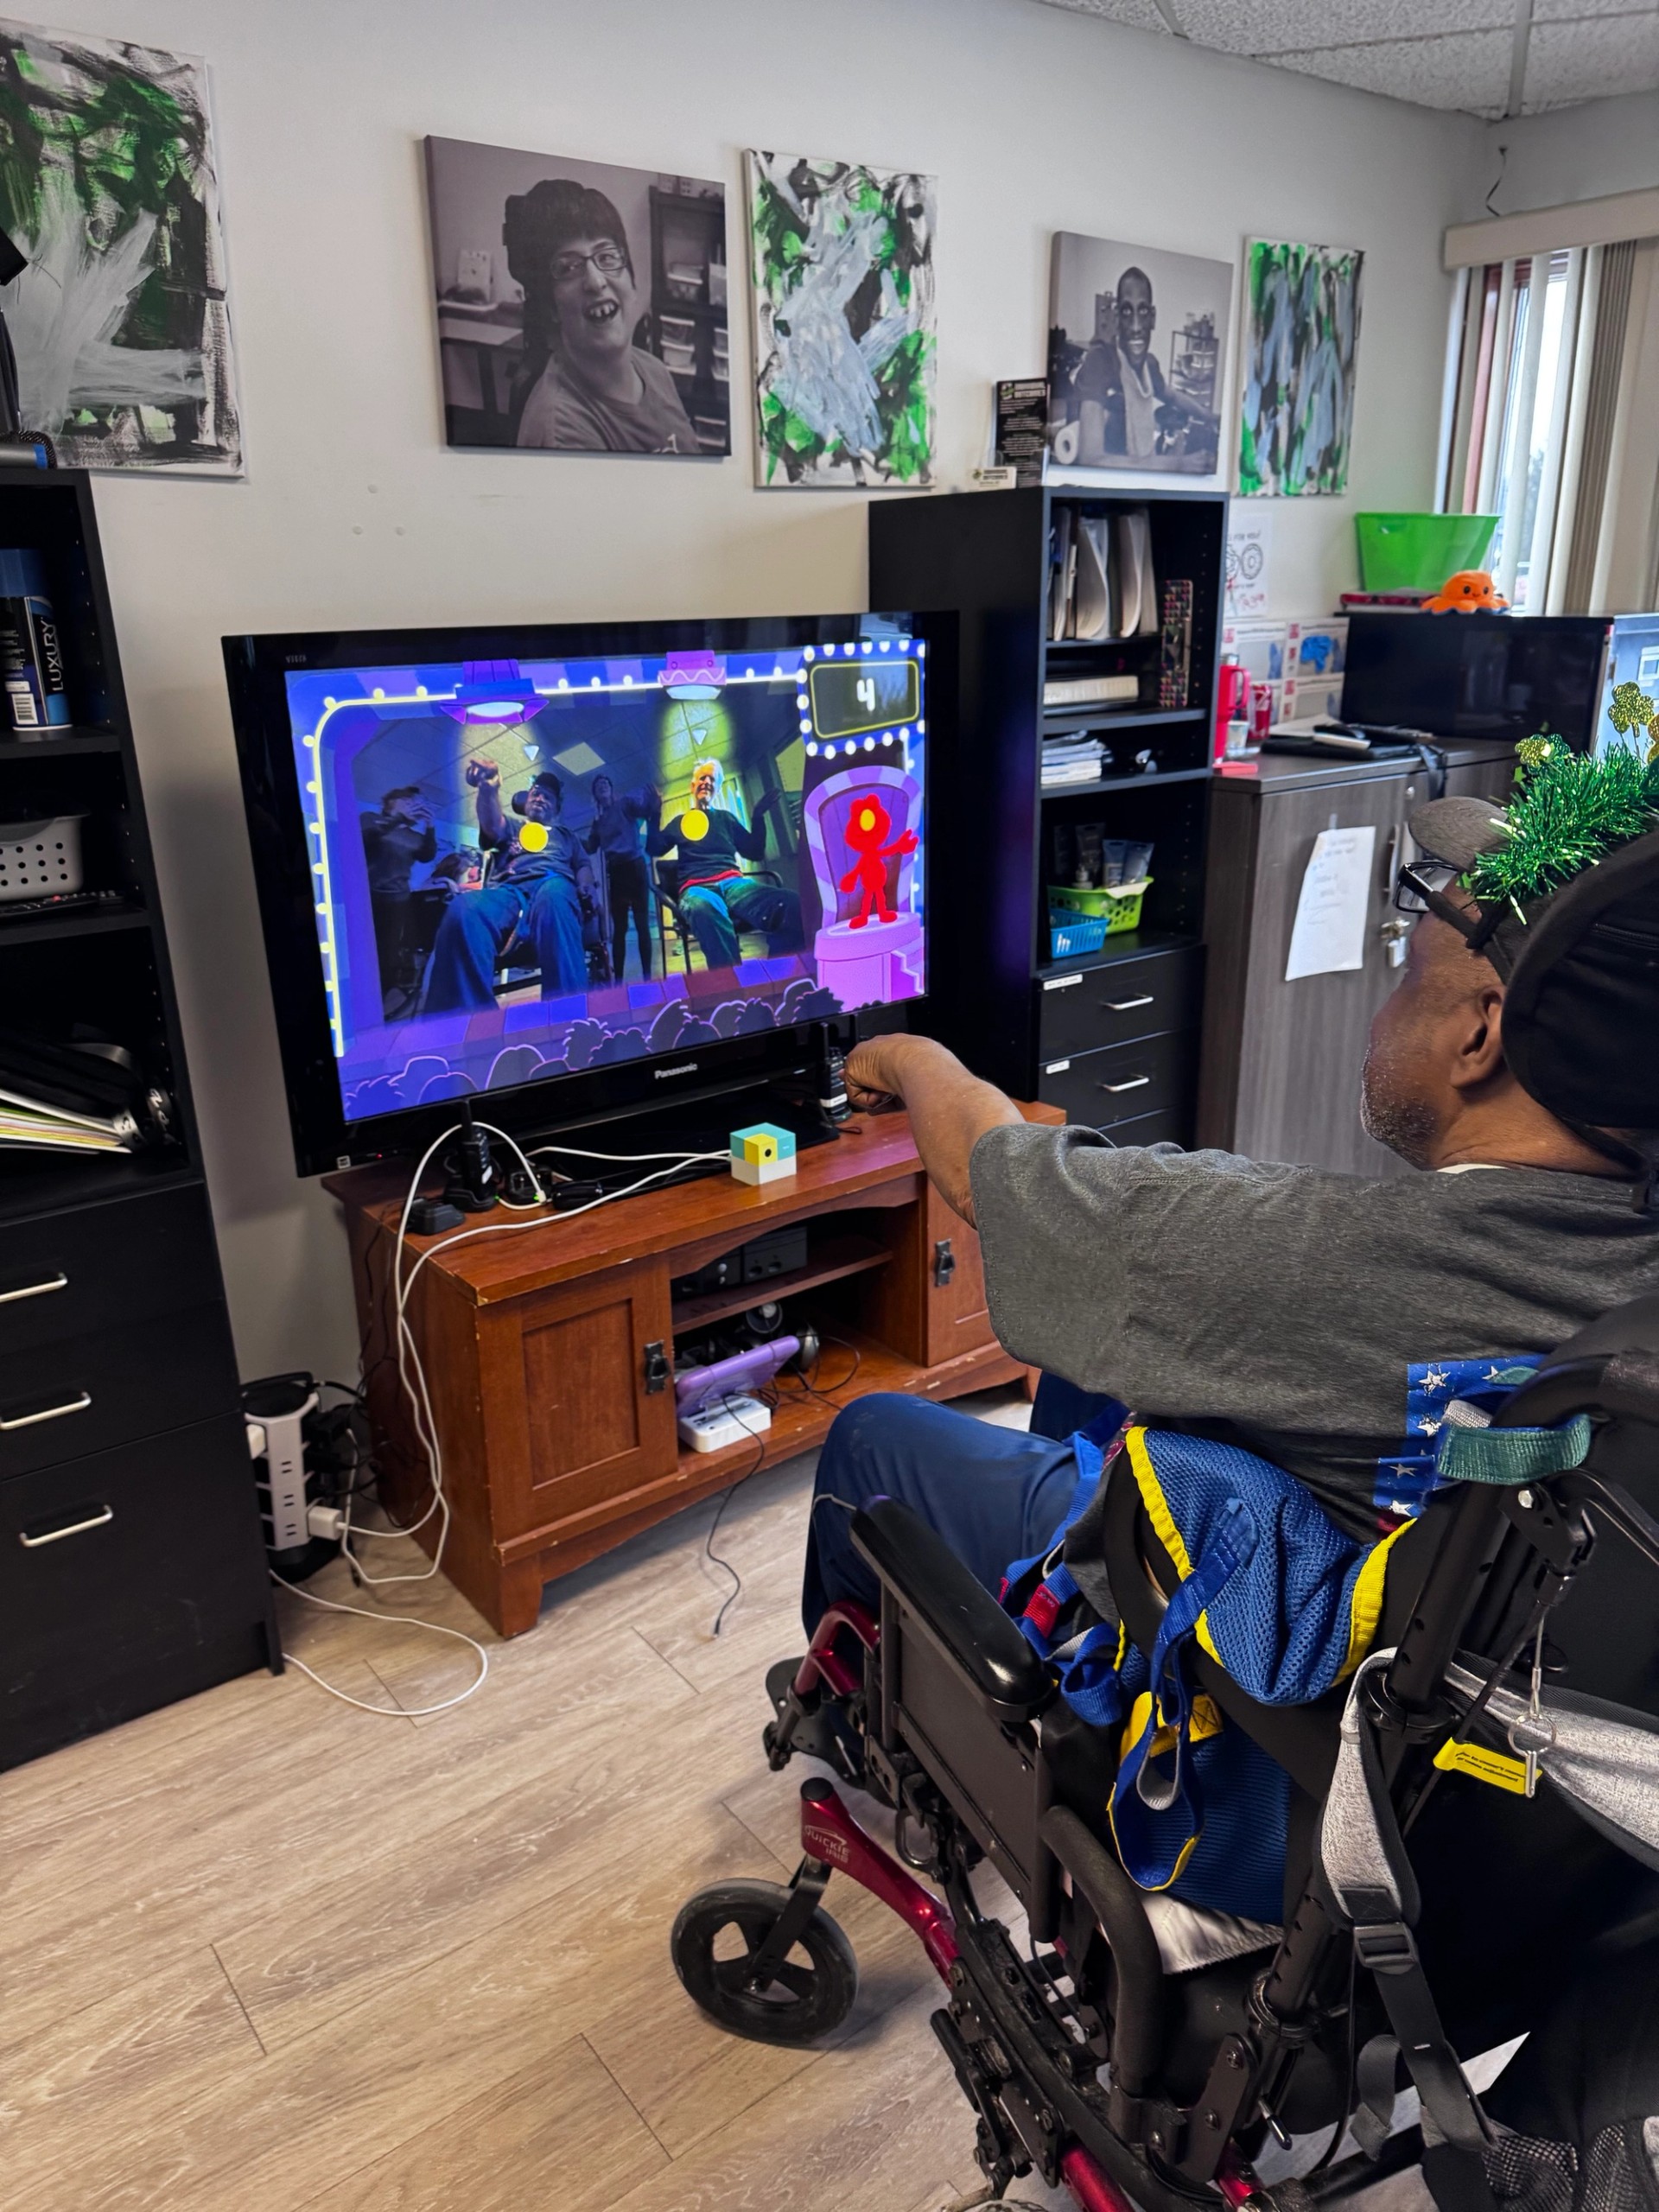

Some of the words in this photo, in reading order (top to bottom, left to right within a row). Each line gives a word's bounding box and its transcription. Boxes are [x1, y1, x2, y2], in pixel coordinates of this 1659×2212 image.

[41, 619, 64, 690] LUXURY
[856, 677, 876, 712] 4
[654, 1063, 698, 1080] Panasonic
[804, 1825, 851, 1855] QUICKIE
